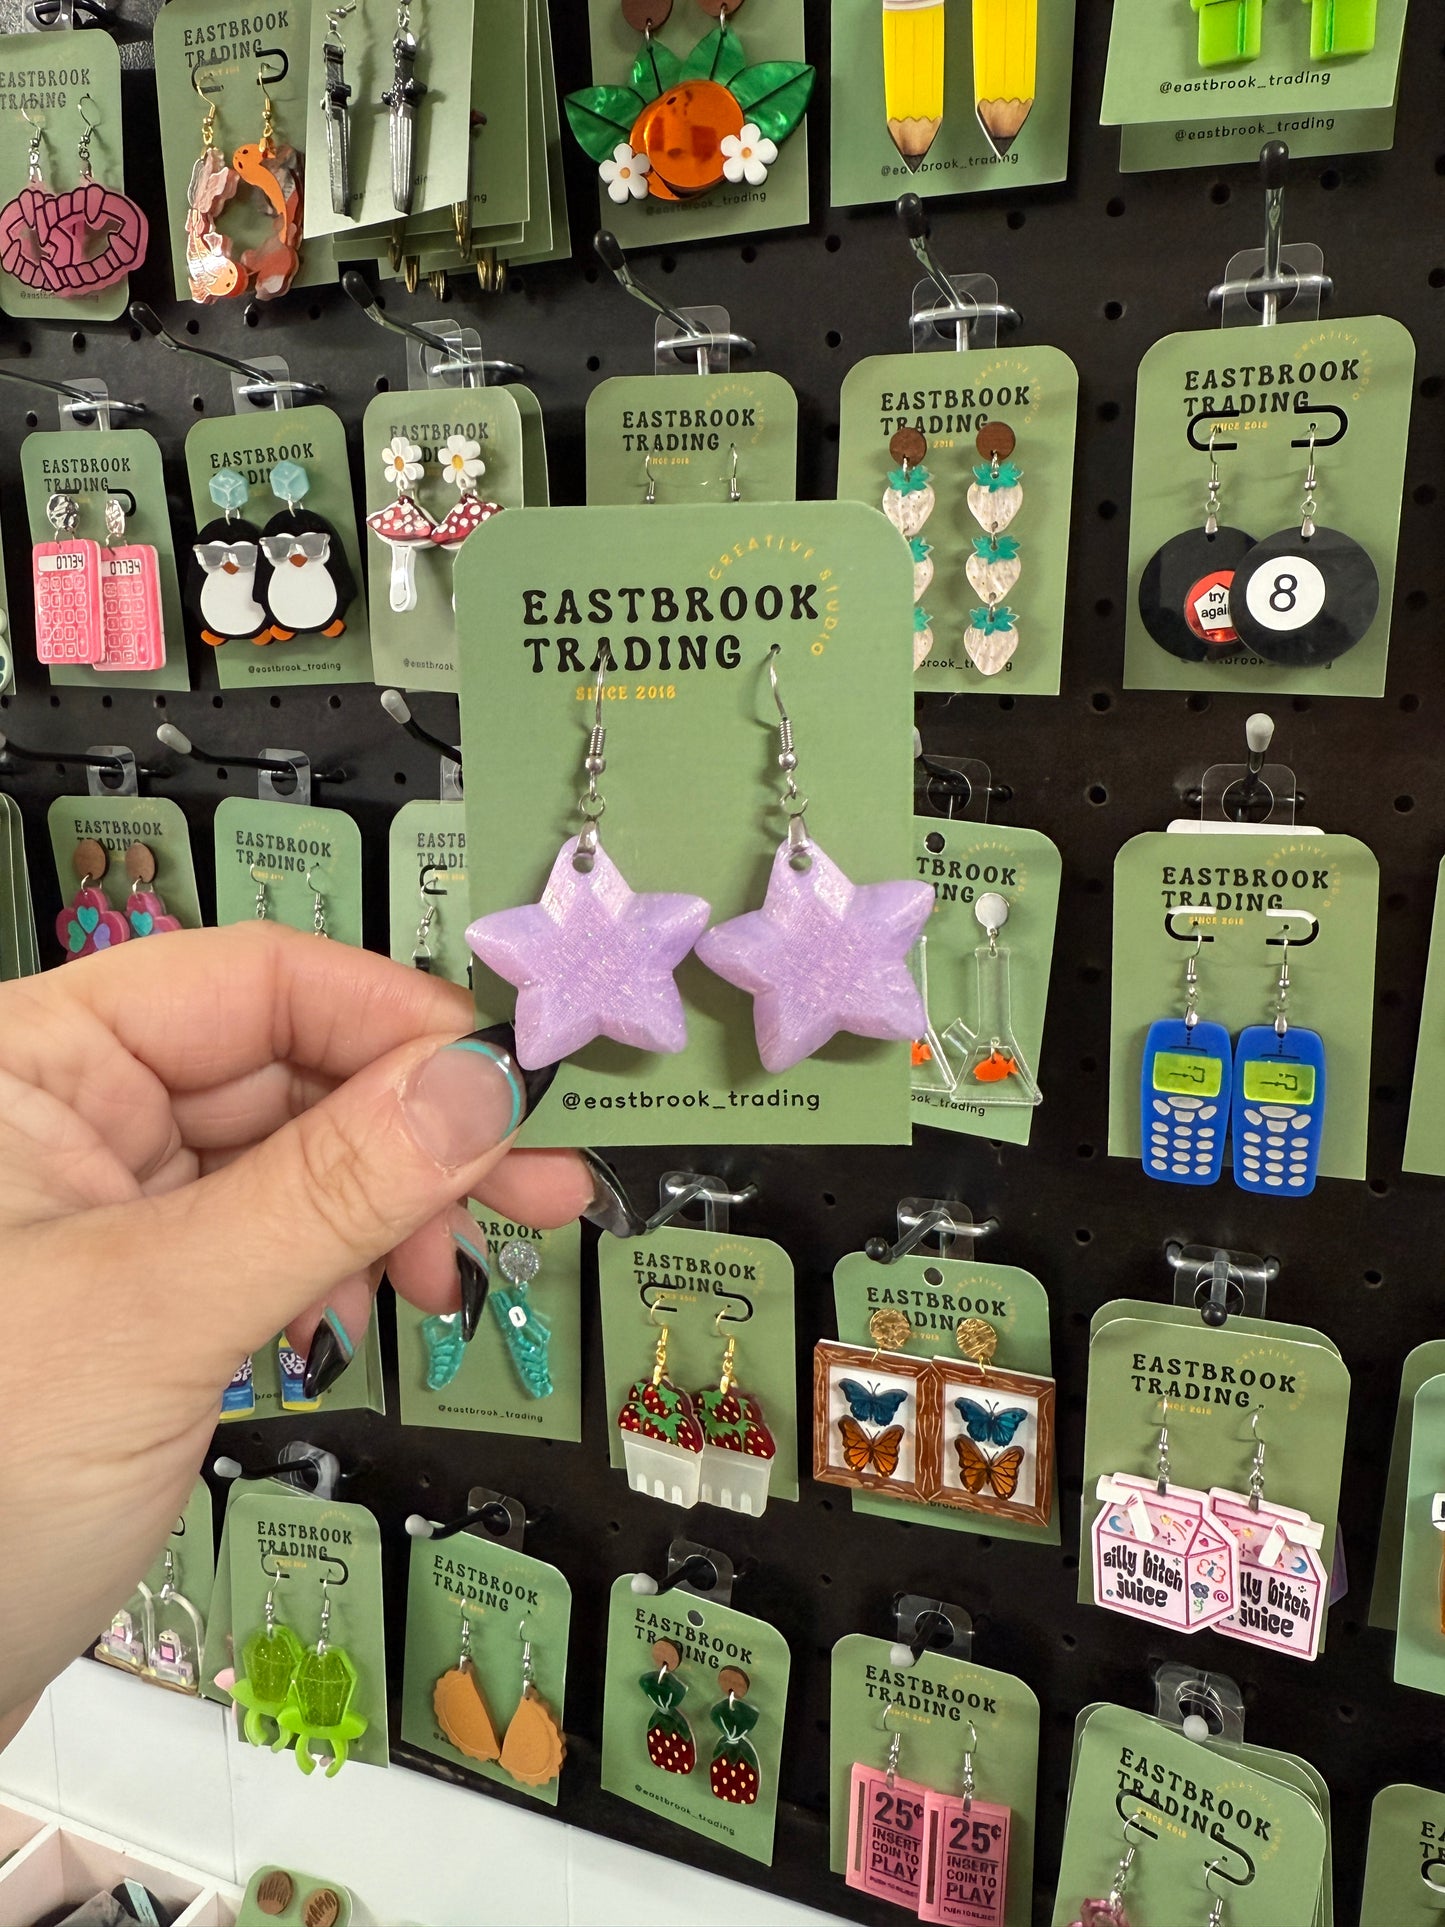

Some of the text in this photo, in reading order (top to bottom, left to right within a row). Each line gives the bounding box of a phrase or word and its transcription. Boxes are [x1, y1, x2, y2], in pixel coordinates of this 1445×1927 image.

[184, 11, 289, 46] EASTBROOK
[185, 39, 263, 68] TRADING
[0, 69, 91, 89] EASTBROOK
[1160, 70, 1331, 94] @eastbrook_trading
[1175, 117, 1335, 142] @eastbrook_trading
[1185, 359, 1360, 391] EASTBROOK
[881, 385, 1031, 412] EASTBROOK
[1183, 390, 1310, 417] TRADING
[622, 408, 756, 429] EASTBROOK
[622, 433, 720, 451] TRADING
[42, 457, 131, 474] EASTBROOK
[210, 443, 314, 469] EASTBROOK
[44, 477, 110, 494] TRADING
[708, 534, 817, 581] CREATIVE
[522, 583, 819, 626] EASTBROOK
[1208, 590, 1225, 605] try
[1269, 573, 1298, 613] 8
[523, 634, 742, 674] TRADING
[575, 685, 629, 701] SINCE
[75, 819, 163, 836] EASTBROOK
[236, 830, 331, 858] EASTBROOK
[236, 849, 306, 872] TRADING
[1162, 866, 1330, 890] EASTBROOK
[1161, 889, 1284, 912] TRADING
[562, 1089, 821, 1111] @eastbrook_trading
[633, 1251, 756, 1281] EASTBROOK
[634, 1270, 724, 1293] TRADING
[867, 1287, 1007, 1317] EASTBROOK
[1132, 1353, 1297, 1394] EASTBROOK
[1131, 1375, 1250, 1408] TRADING
[257, 1521, 353, 1545] EASTBROOK
[434, 1555, 539, 1606] EASTBROOK
[1103, 1545, 1183, 1593] silly bitch
[432, 1572, 510, 1612] TRADING
[1116, 1573, 1168, 1608] juice
[1268, 1574, 1311, 1623] bitch
[1239, 1603, 1294, 1638] juice
[634, 1607, 752, 1664] EASTBROOK
[865, 1683, 961, 1721] TRADING
[866, 1664, 997, 1714] EASTBROOK
[1117, 1769, 1226, 1838] TRADING
[1119, 1747, 1272, 1842] EASTBROOK
[872, 1827, 920, 1851] INSERT
[872, 1841, 919, 1866] COIN TO
[947, 1855, 999, 1876] INSERT
[871, 1854, 918, 1882] PLAY
[946, 1868, 997, 1889] COIN TO
[946, 1882, 995, 1906] PLAY
